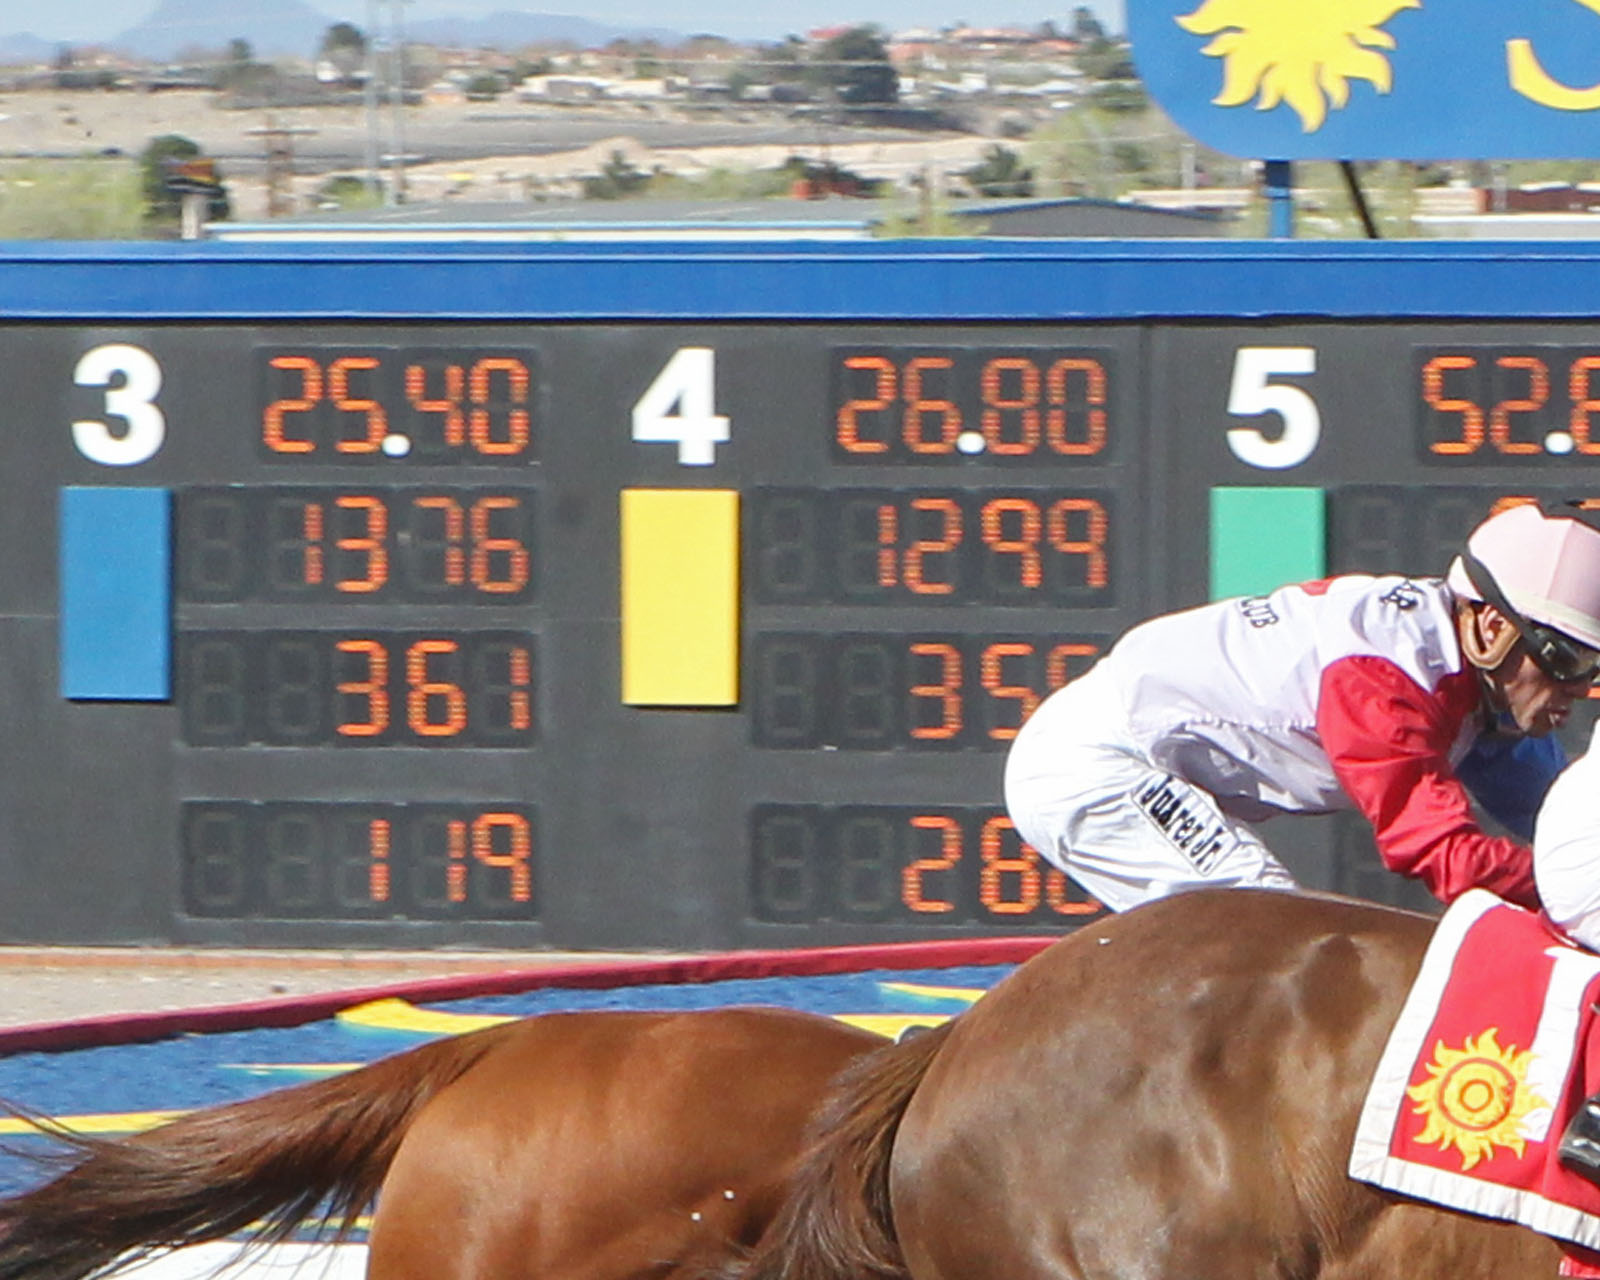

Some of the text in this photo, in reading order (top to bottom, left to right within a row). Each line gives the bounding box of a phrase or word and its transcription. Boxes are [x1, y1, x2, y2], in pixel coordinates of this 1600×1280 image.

[71, 344, 166, 466] 3
[263, 357, 530, 455] 25.40
[631, 348, 731, 466] 4
[836, 357, 1107, 455] 26.80
[1226, 347, 1321, 469] 5
[304, 497, 530, 593] 1376
[878, 499, 1108, 594] 1299
[336, 640, 531, 736] 361
[370, 812, 531, 902] 119
